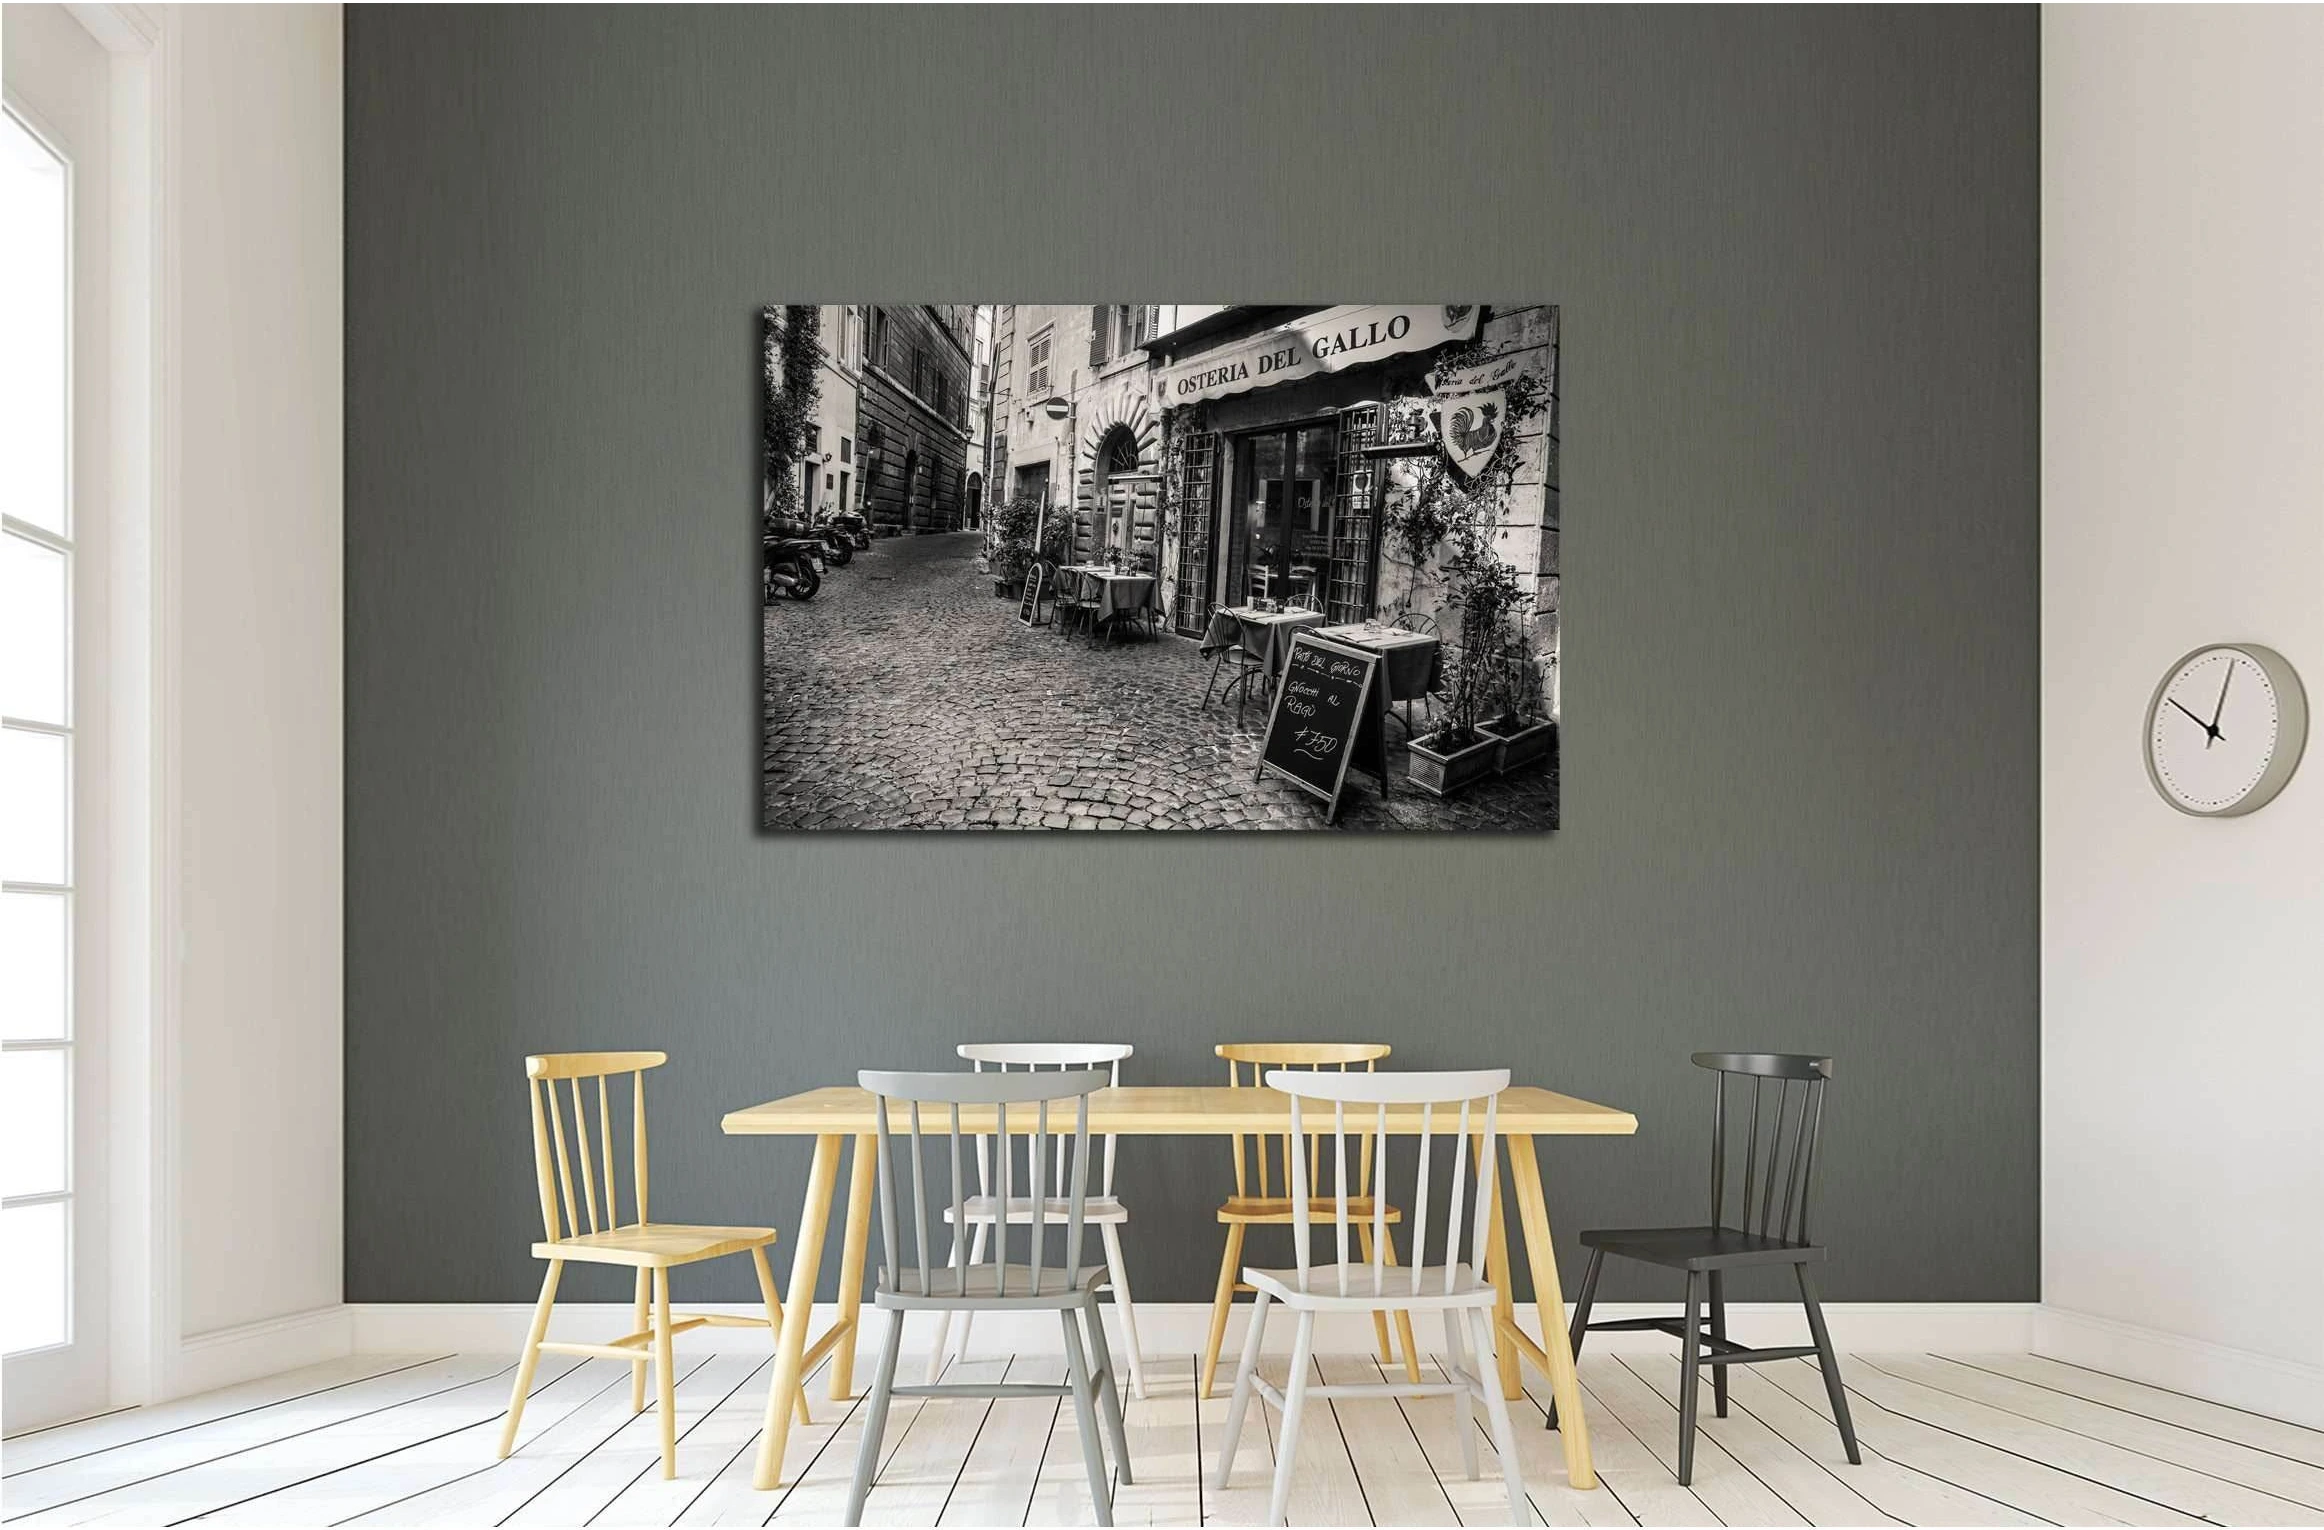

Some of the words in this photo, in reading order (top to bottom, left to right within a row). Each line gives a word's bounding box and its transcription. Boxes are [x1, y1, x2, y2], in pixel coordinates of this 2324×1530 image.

[1177, 361, 1249, 396] OSTERIA
[1257, 347, 1302, 375] DEL
[1312, 315, 1411, 359] GALLO
